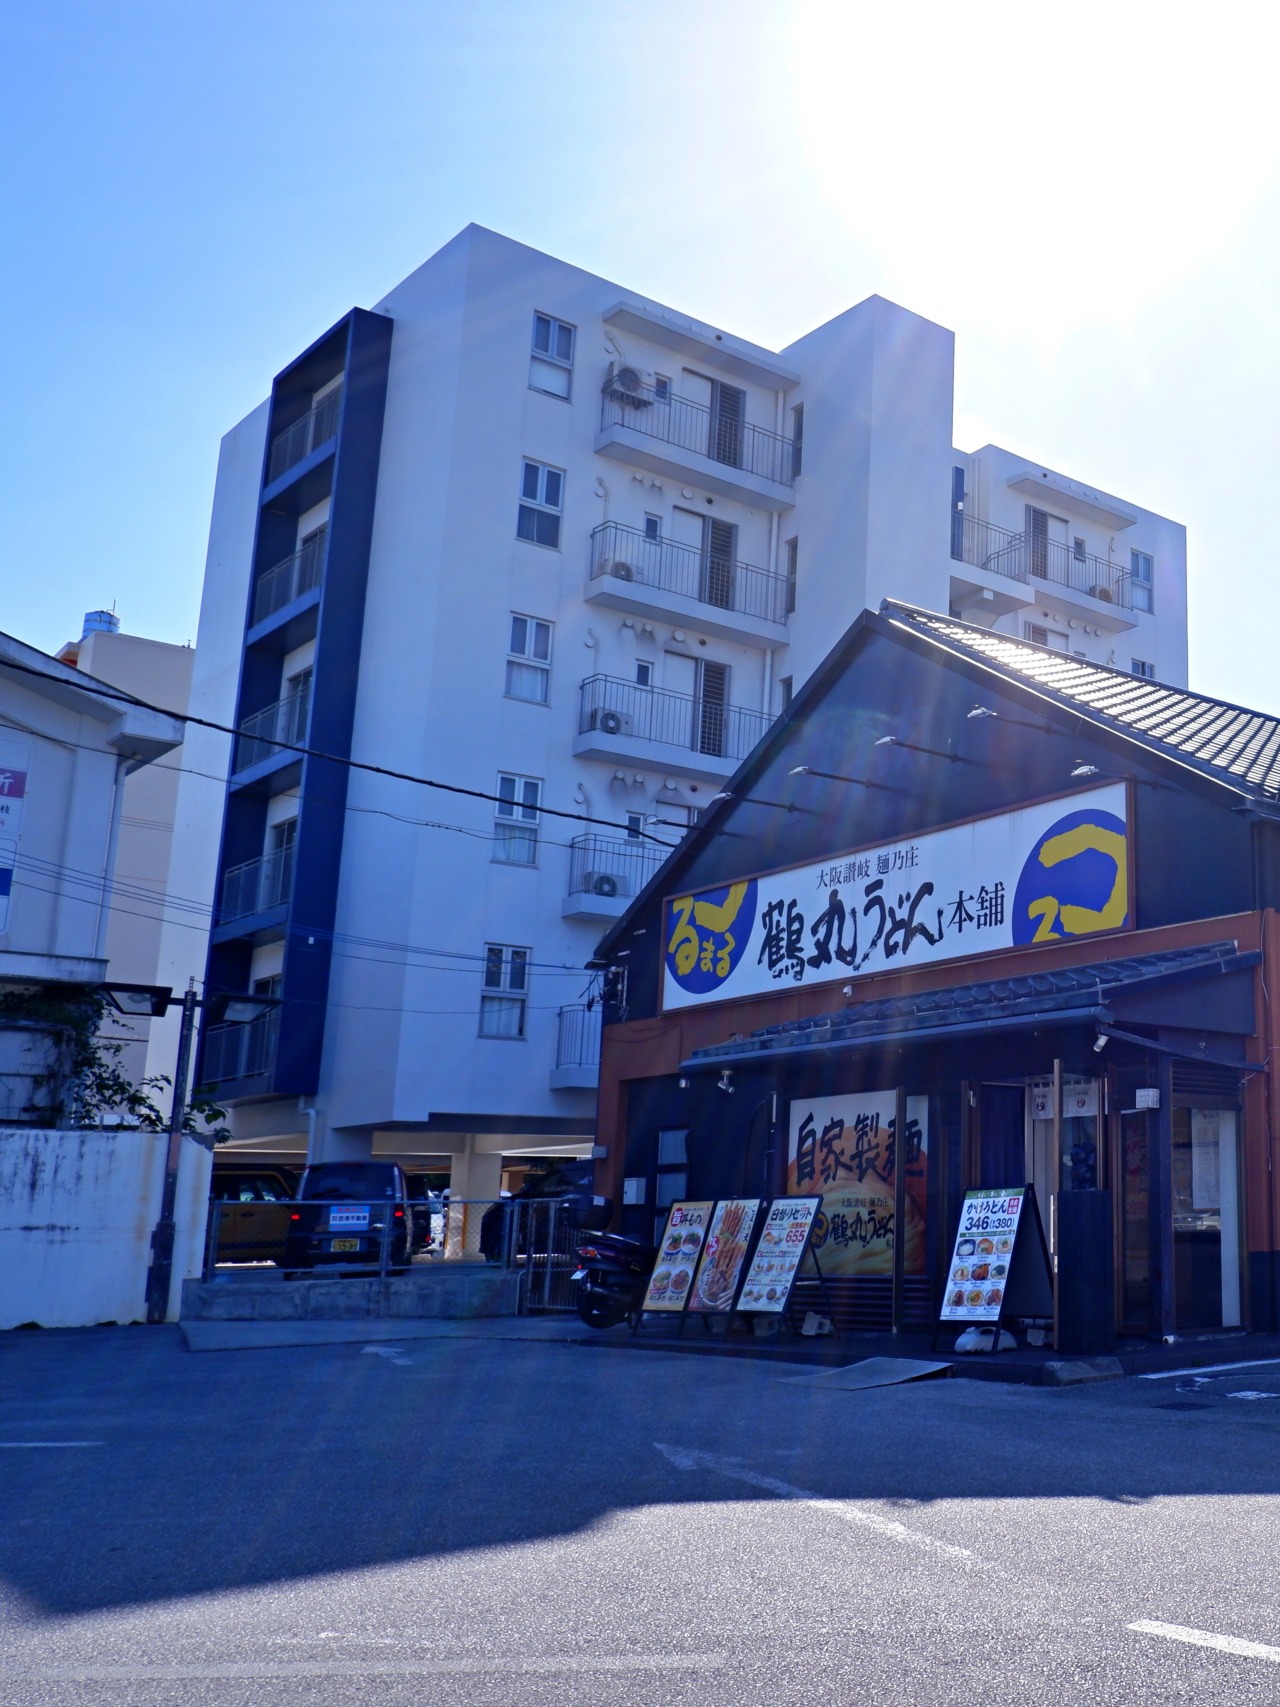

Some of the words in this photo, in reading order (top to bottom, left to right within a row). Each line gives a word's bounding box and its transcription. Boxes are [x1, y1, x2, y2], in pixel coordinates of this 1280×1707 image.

[796, 1112, 923, 1187] 自家製麺
[967, 1200, 1007, 1215] かけうどん
[965, 1216, 990, 1231] 346
[786, 1229, 806, 1243] 655
